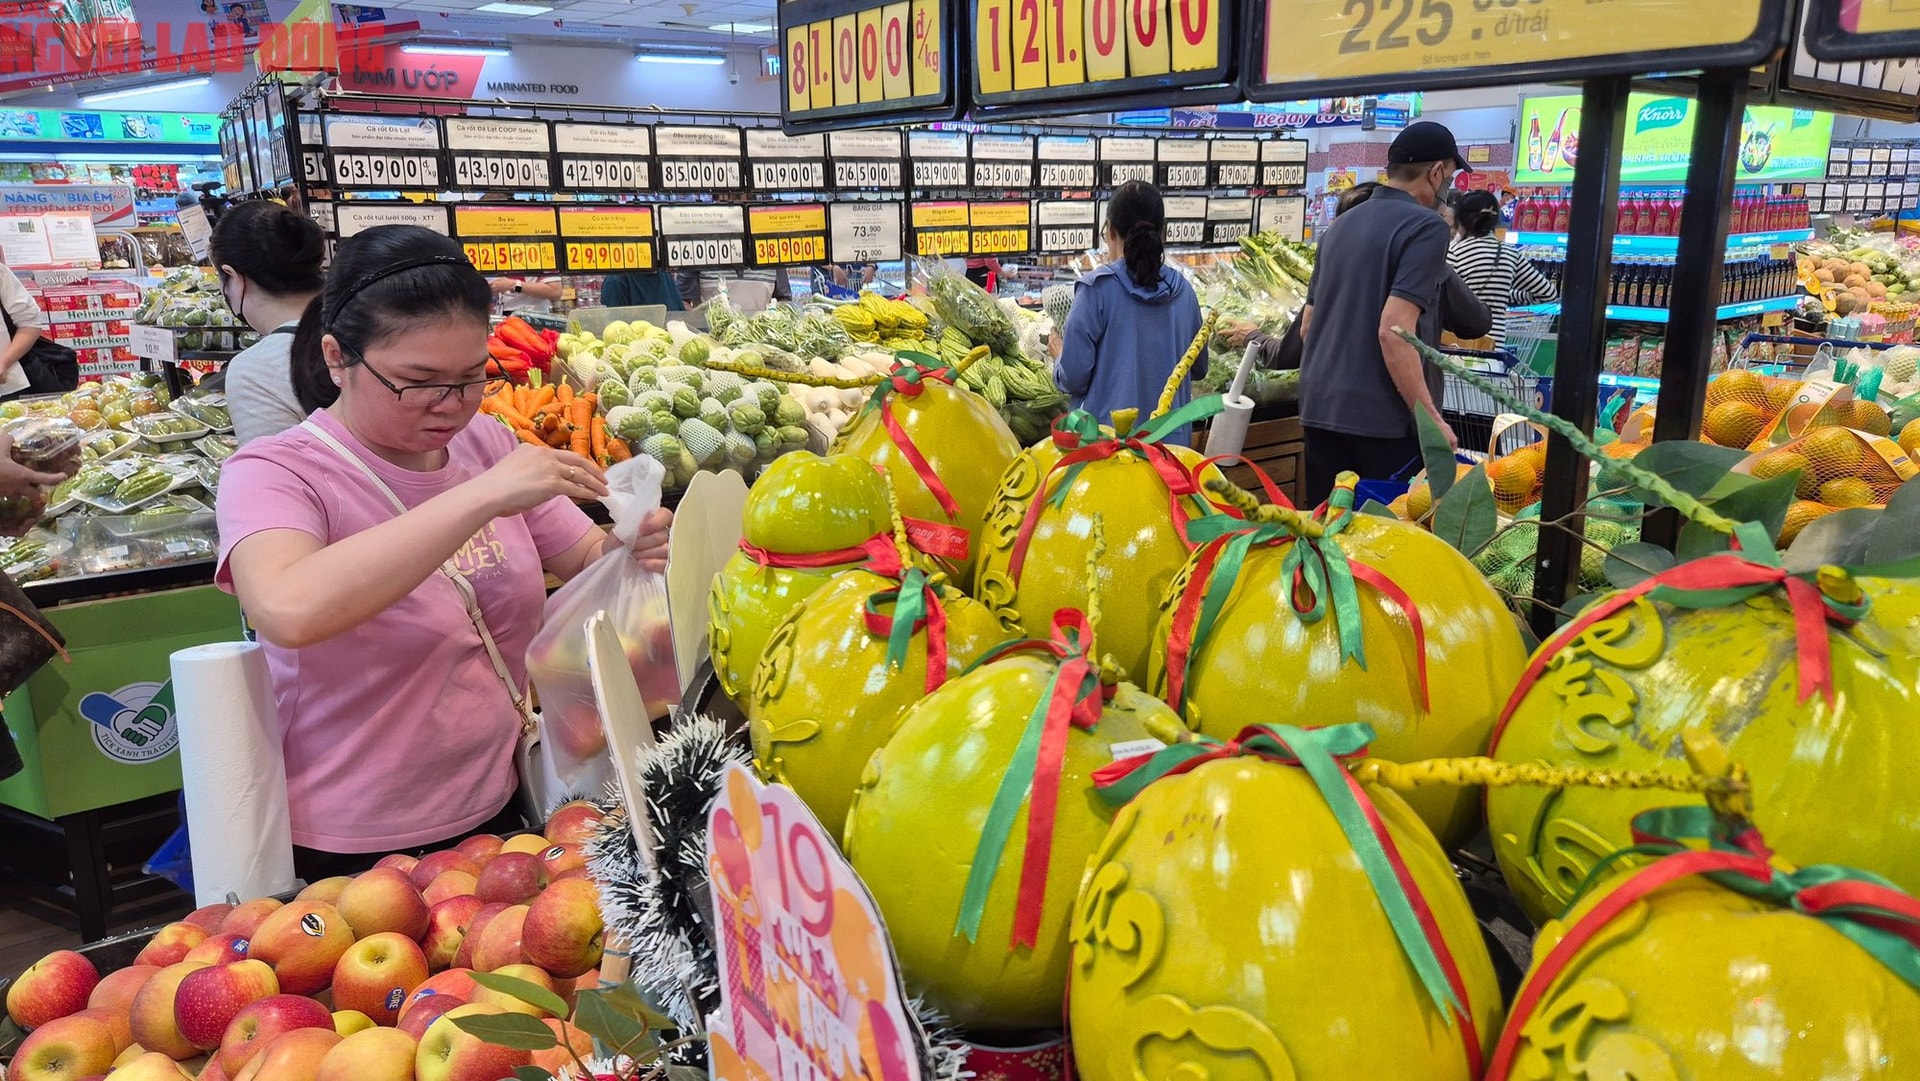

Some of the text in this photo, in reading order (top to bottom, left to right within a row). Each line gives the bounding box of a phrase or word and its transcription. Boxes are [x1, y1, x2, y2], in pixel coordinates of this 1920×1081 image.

[988, 0, 1208, 73] 121.000
[793, 16, 900, 94] 81.000
[487, 81, 578, 95] MARINATED FOOD
[1254, 113, 1310, 128] Ready
[1639, 107, 1683, 121] Knorr
[339, 159, 417, 179] 63.900
[458, 161, 531, 181] 43.900
[566, 163, 632, 182] 42.900
[665, 165, 725, 182] 85.000
[757, 166, 810, 183] 10.900
[838, 166, 888, 181] 26.500
[915, 166, 957, 180] 83.900
[976, 167, 1020, 181] 63.500
[1042, 167, 1083, 181] 75.000
[4, 191, 47, 203] NÂNG
[67, 193, 91, 203] BIA
[93, 191, 113, 202] ÊM
[92, 203, 115, 213] NỐI
[400, 214, 417, 222] 500g
[975, 232, 1017, 248] 55.000
[1044, 232, 1084, 246] 10.500
[468, 247, 538, 265] 32.500
[570, 247, 634, 264] 29.900
[671, 244, 729, 260] 66.000
[758, 241, 812, 259] 38.900
[67, 309, 125, 319] Heineken
[72, 336, 130, 346] Heineken
[102, 733, 114, 749] TICK
[114, 745, 139, 758] XANH
